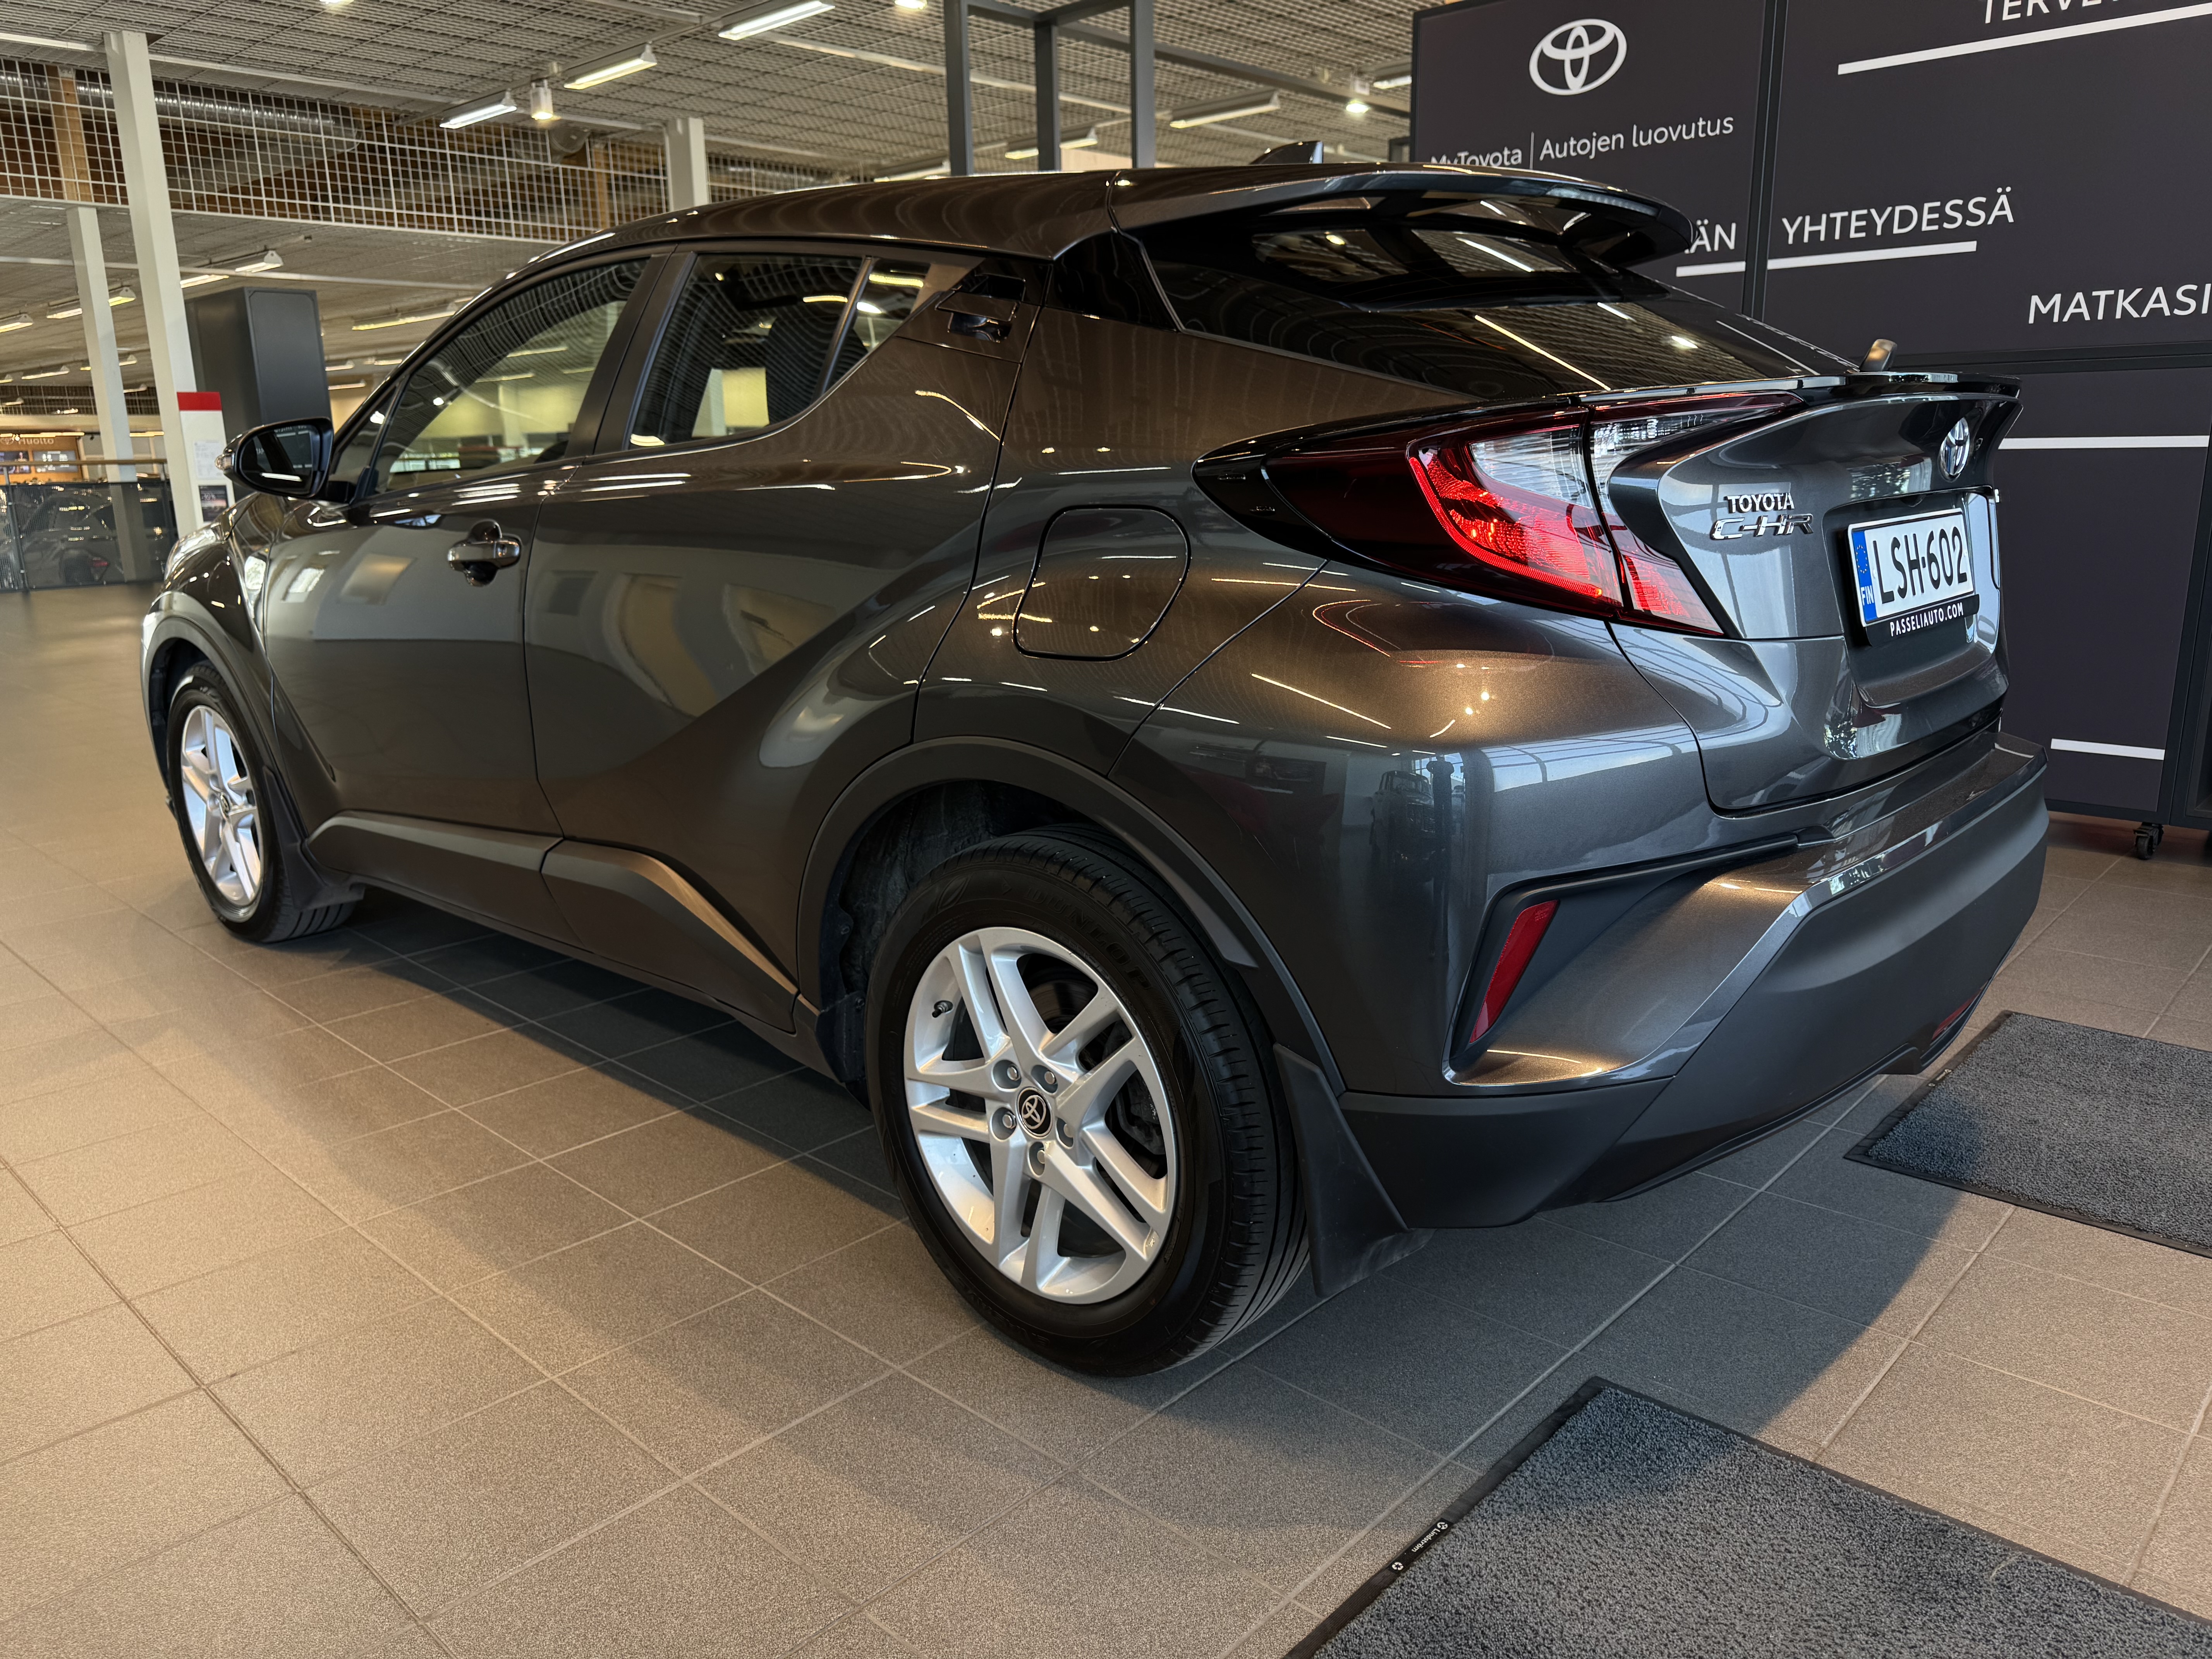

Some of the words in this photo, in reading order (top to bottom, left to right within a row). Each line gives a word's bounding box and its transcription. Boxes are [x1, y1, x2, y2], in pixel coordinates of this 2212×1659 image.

[1539, 132, 1624, 161] Autojen
[1632, 117, 1734, 148] luovutus
[1684, 218, 1736, 254] ÄN
[1781, 186, 2014, 245] YHTEYDESSÄ
[1725, 492, 1795, 514] TOYOTA
[1710, 513, 1814, 540] C-HR
[1873, 526, 1968, 604] LSH-602
[1860, 585, 1874, 606] FIN
[1890, 602, 1964, 637] PASSELIAUTO.COM
[1022, 886, 1153, 990] DUNLOP
[1411, 1528, 1441, 1553] Lindström
